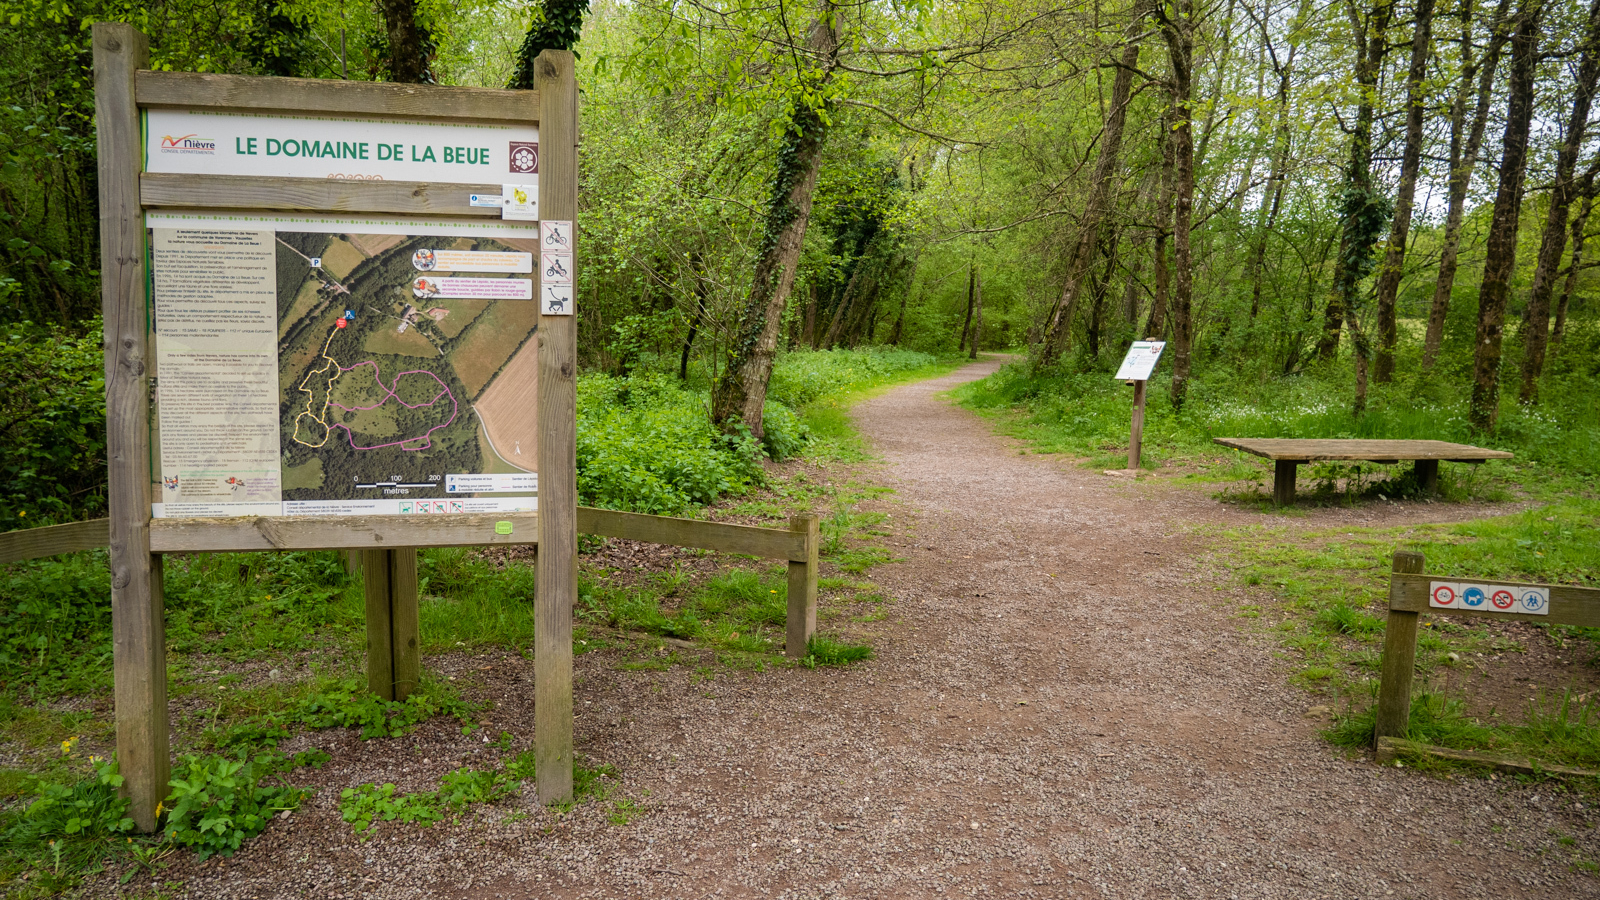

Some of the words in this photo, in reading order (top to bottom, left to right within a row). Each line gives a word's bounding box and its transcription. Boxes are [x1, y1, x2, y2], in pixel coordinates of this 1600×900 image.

[236, 136, 257, 155] LE
[266, 138, 369, 160] DOMAINE
[378, 143, 404, 161] DE
[412, 144, 437, 162] LA
[444, 146, 489, 165] BEUE
